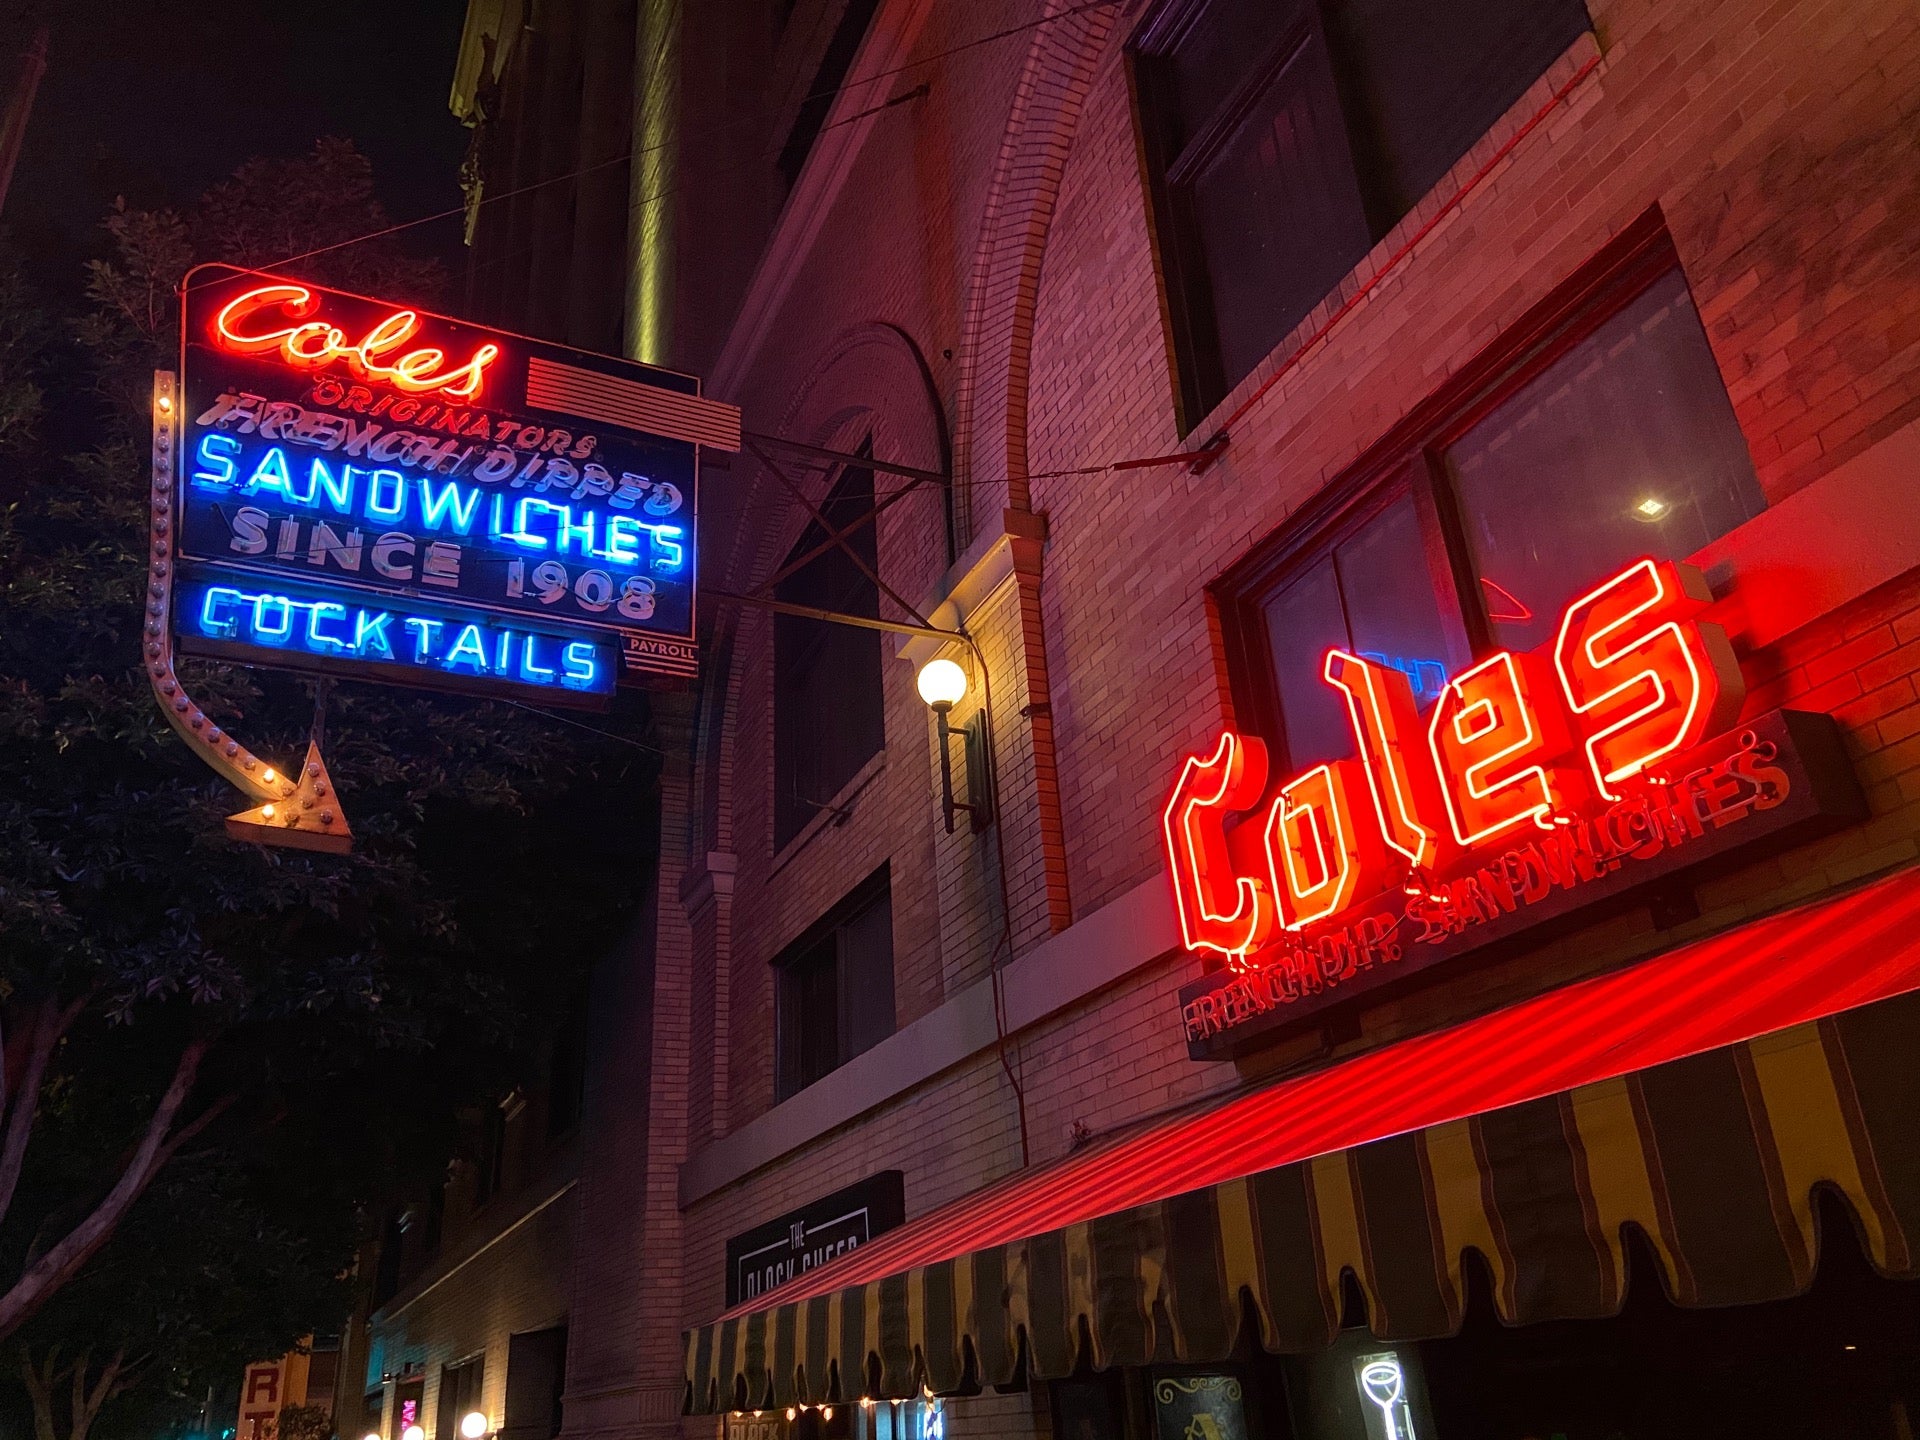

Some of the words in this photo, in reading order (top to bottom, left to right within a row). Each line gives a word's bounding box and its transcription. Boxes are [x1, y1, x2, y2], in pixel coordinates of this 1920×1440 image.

[212, 286, 500, 400] Coles
[196, 392, 474, 474] FRENCH
[473, 444, 684, 517] DIPPED
[312, 375, 598, 460] ORIGINATORS
[192, 433, 686, 575] SANDWICHES
[230, 507, 462, 589] SINCE
[507, 557, 655, 621] 1908
[200, 587, 598, 686] COCKTAILS
[630, 638, 695, 660] PAYROLL
[1163, 559, 1722, 958] Coles
[1183, 948, 1322, 1042] FRENCH
[1405, 738, 1790, 945] SANDWICHES
[789, 1220, 805, 1250] THE
